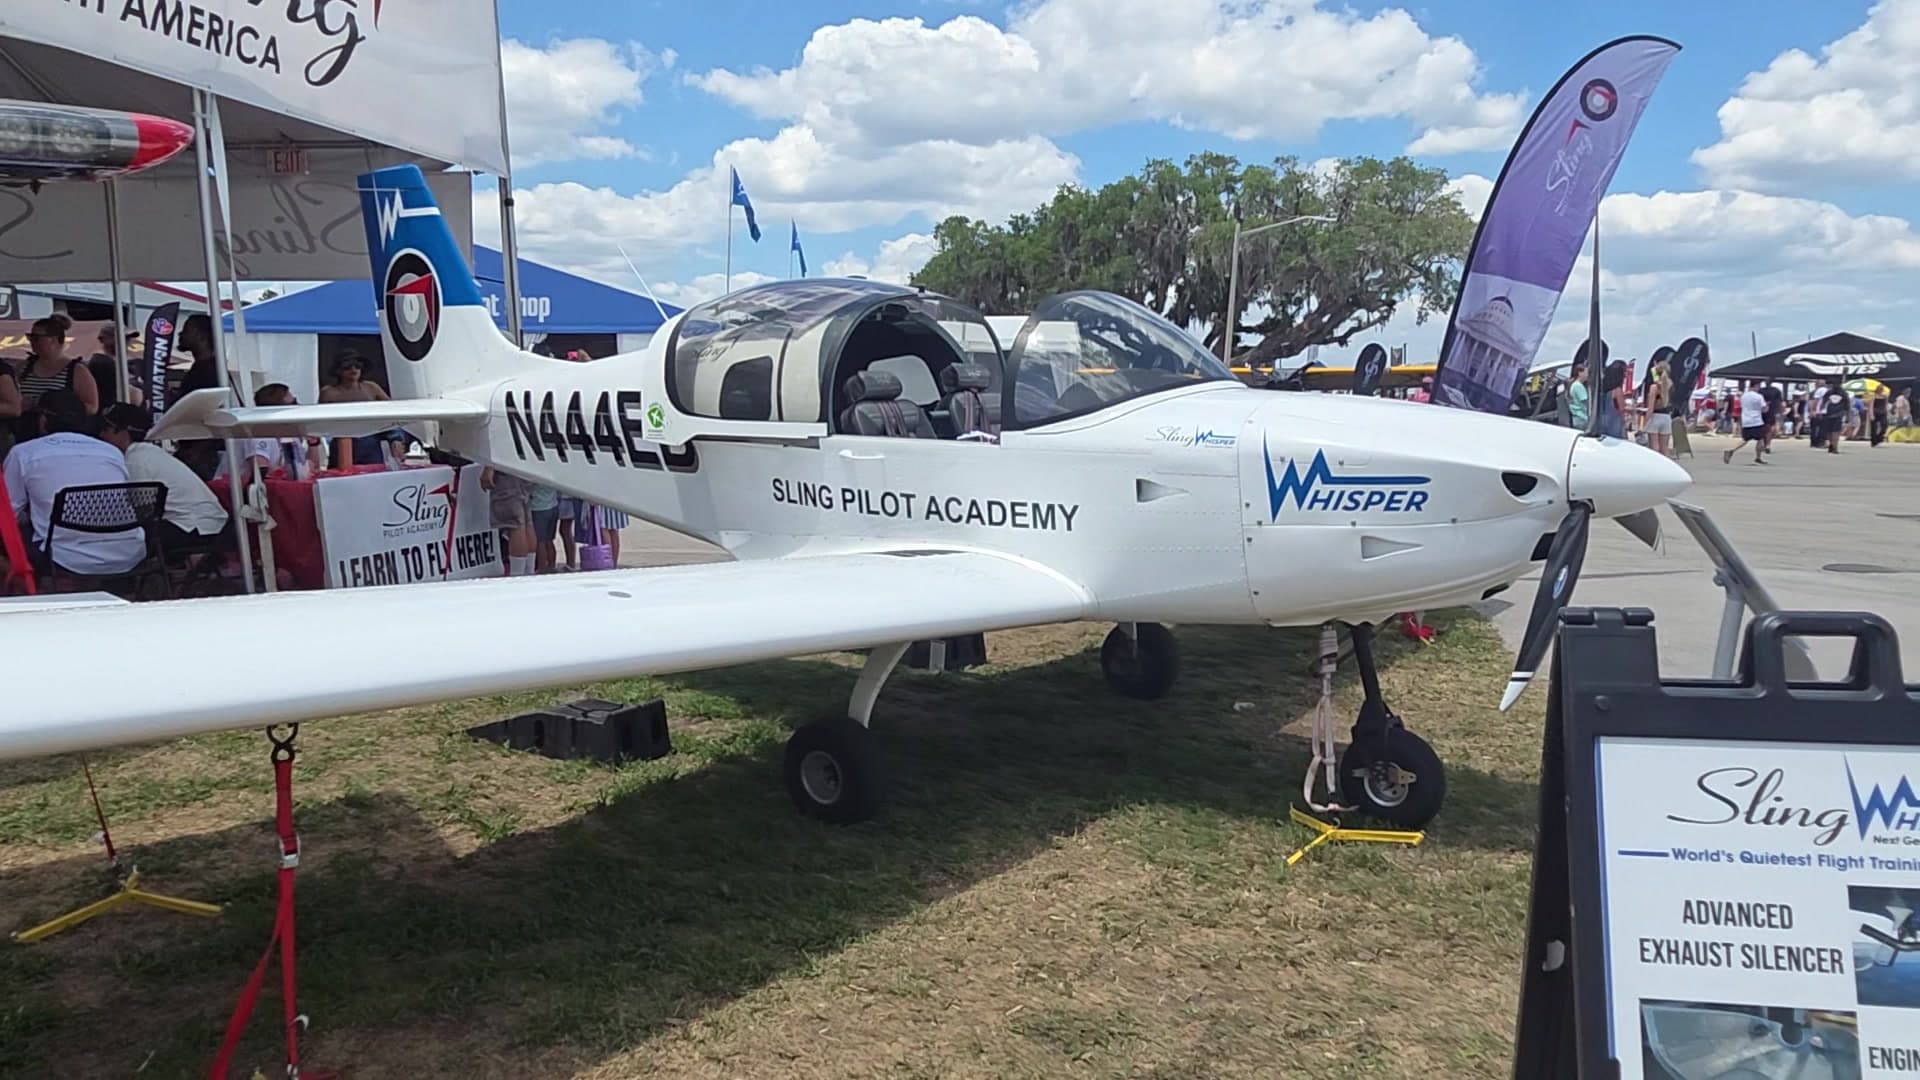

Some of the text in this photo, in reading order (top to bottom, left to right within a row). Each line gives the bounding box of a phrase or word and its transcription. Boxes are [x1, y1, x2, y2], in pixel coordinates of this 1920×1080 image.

[120, 0, 282, 74] AMERICA
[152, 336, 169, 413] AVIATION
[1144, 426, 1195, 448] Sling
[1263, 426, 1432, 524] WHISPER
[382, 483, 449, 529] Sling
[772, 478, 1079, 532] SLING PILOT ACADEMY
[401, 545, 424, 583] TO
[456, 530, 495, 570] HERE!
[1666, 767, 1850, 847] Sling
[1671, 848, 1920, 872] World's Quietest Flight Traini
[1682, 899, 1794, 930] ADVANCED
[1639, 938, 1845, 974] EXHAUST SILENCER
